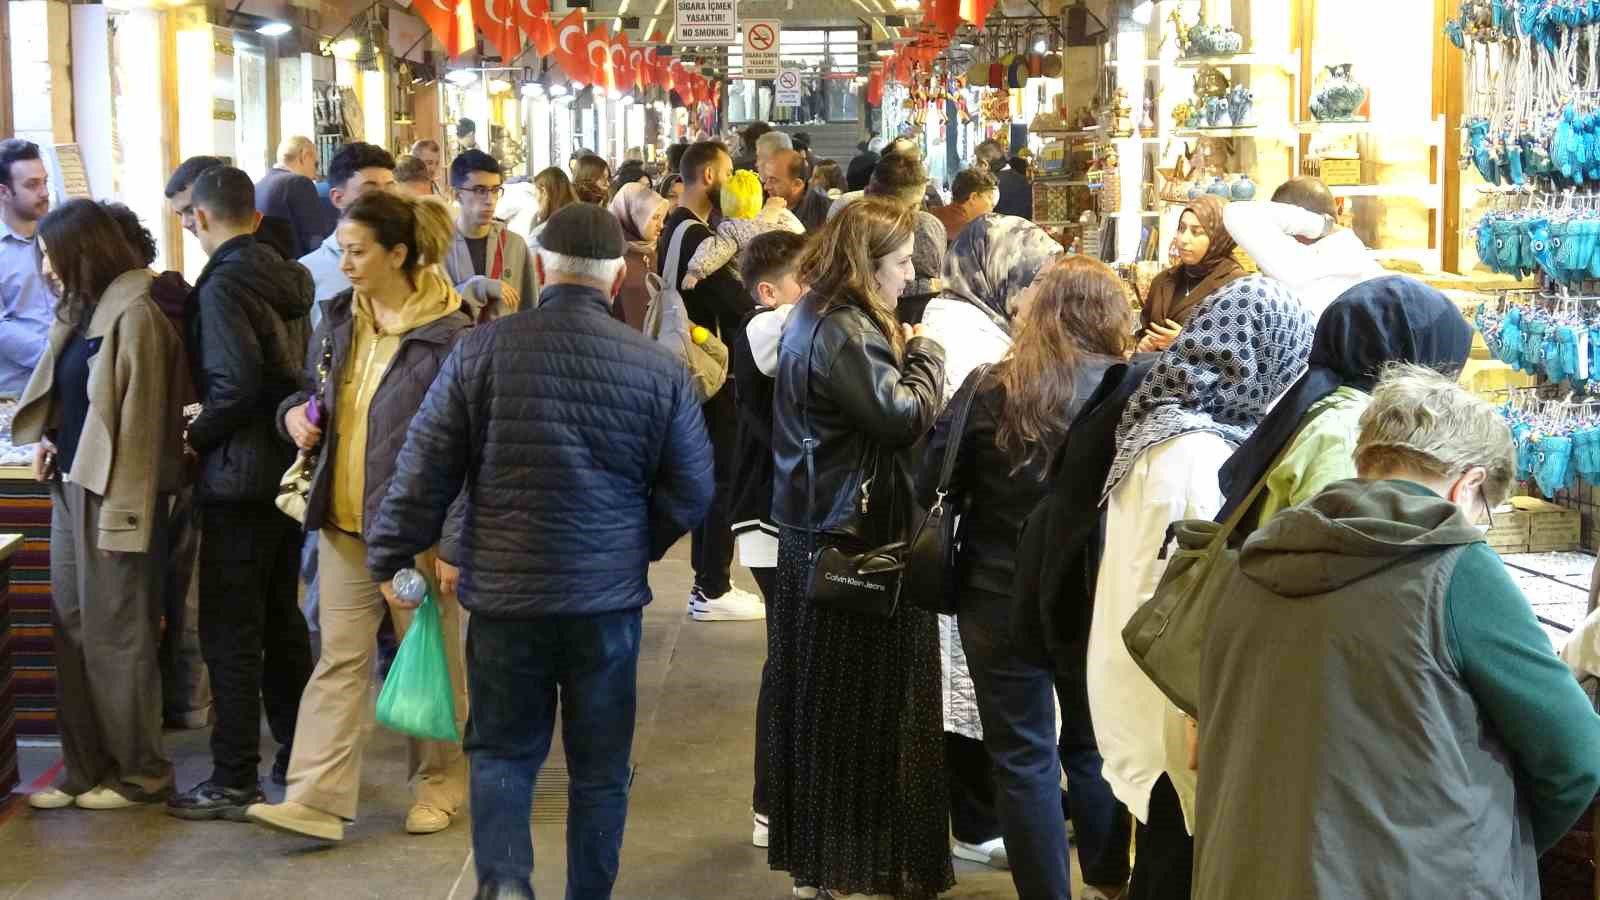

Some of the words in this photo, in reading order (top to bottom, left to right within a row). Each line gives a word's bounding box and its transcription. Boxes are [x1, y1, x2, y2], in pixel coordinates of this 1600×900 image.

[686, 13, 726, 22] YASAKTIR!
[682, 28, 693, 37] NO
[694, 28, 729, 37] SMOKING
[825, 572, 847, 584] Calvin
[847, 576, 864, 587] Klein
[864, 580, 886, 591] Jeans
